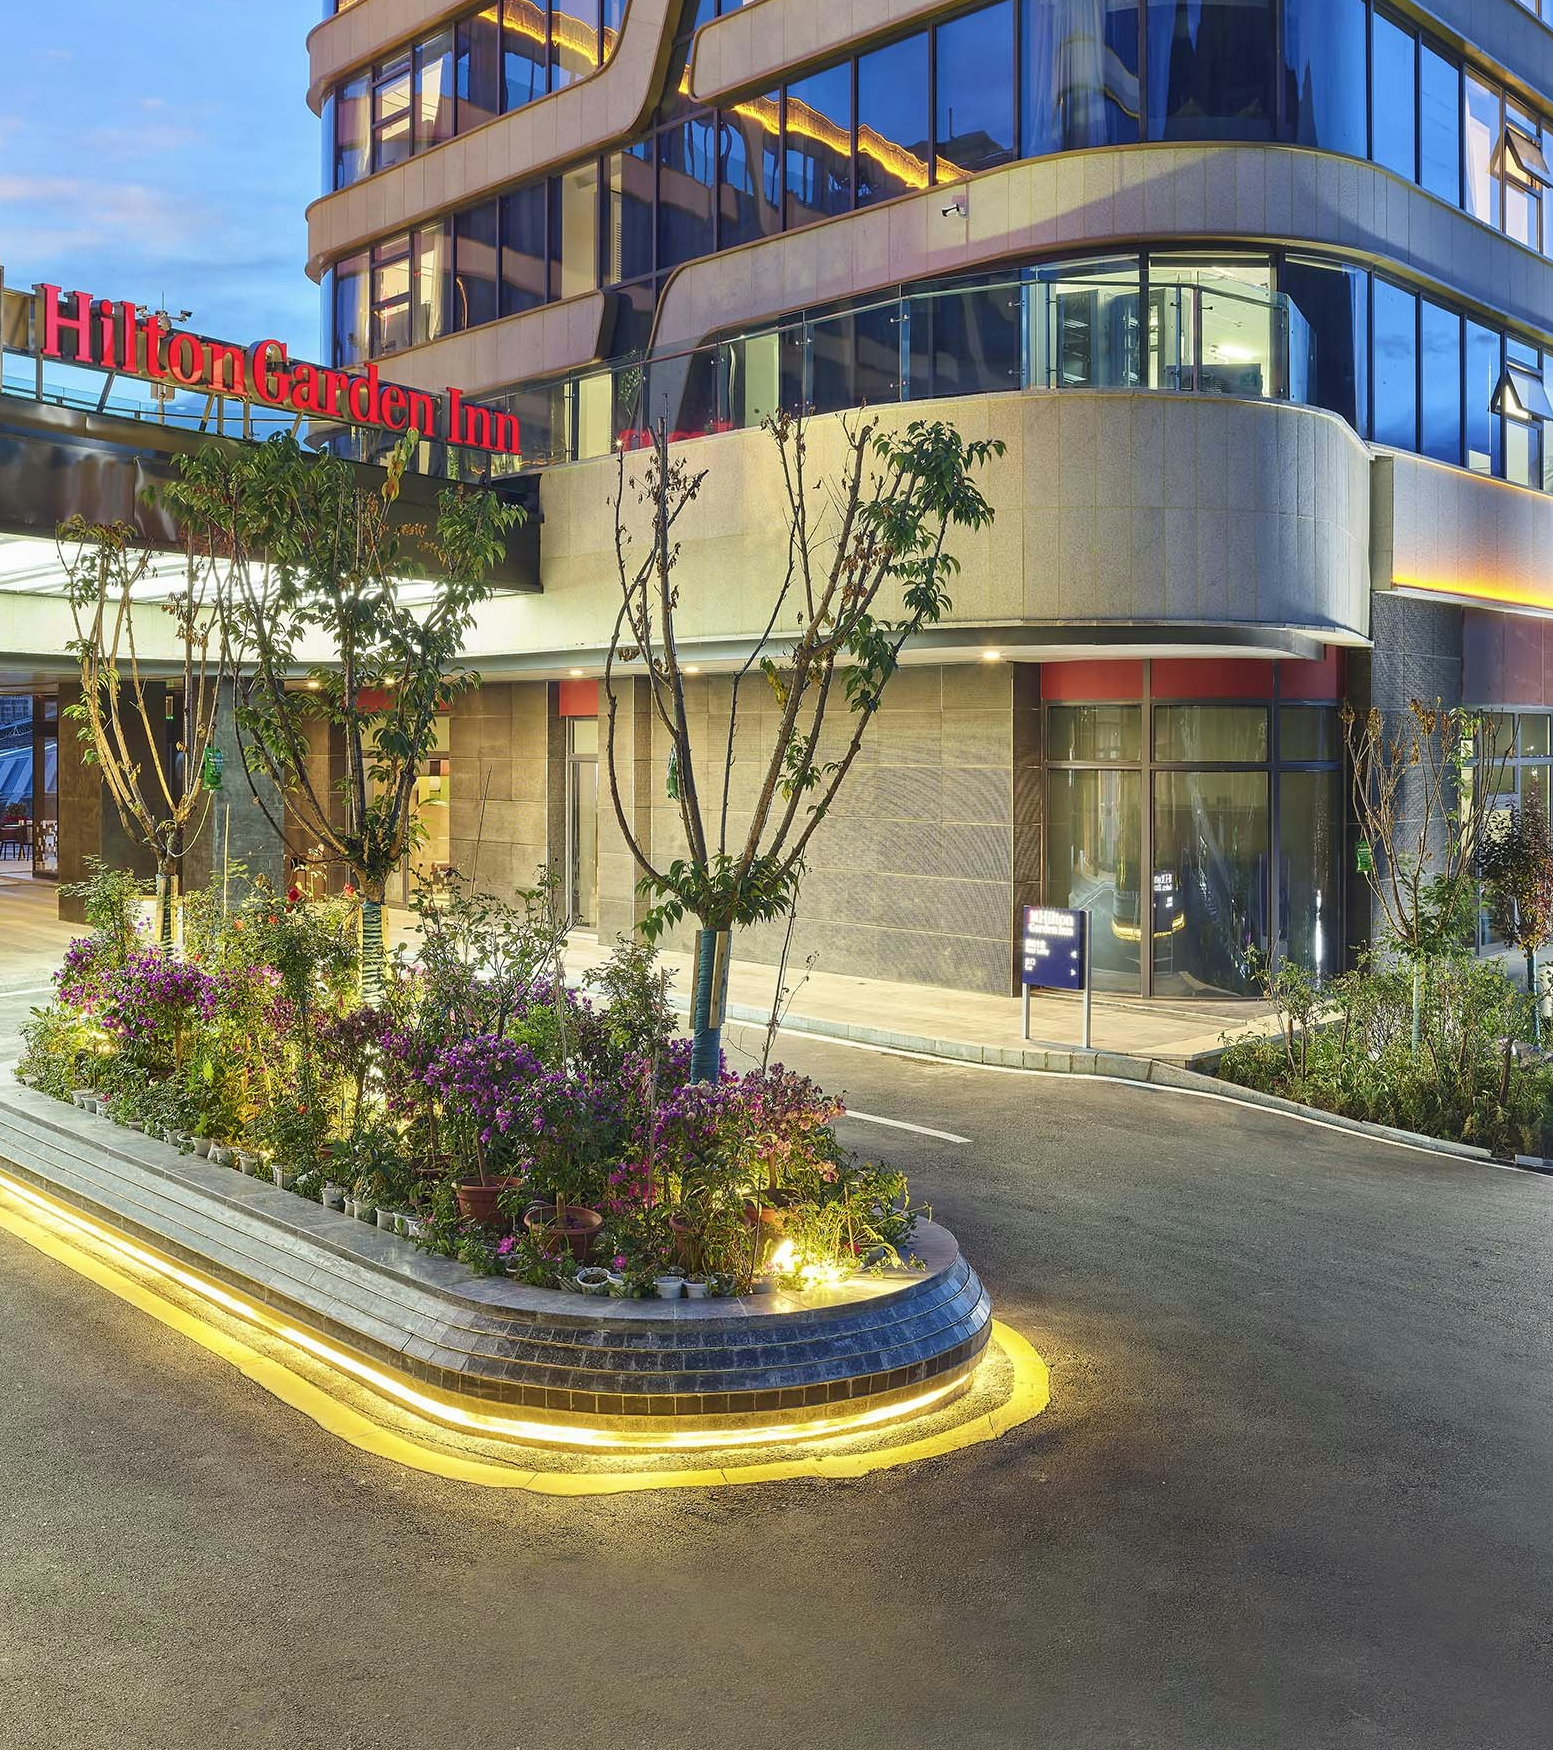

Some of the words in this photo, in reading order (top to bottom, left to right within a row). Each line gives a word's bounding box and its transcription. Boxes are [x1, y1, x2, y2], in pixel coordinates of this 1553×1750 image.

[41, 283, 249, 397] Hilton
[251, 338, 435, 438] Garden
[446, 386, 523, 455] Inn
